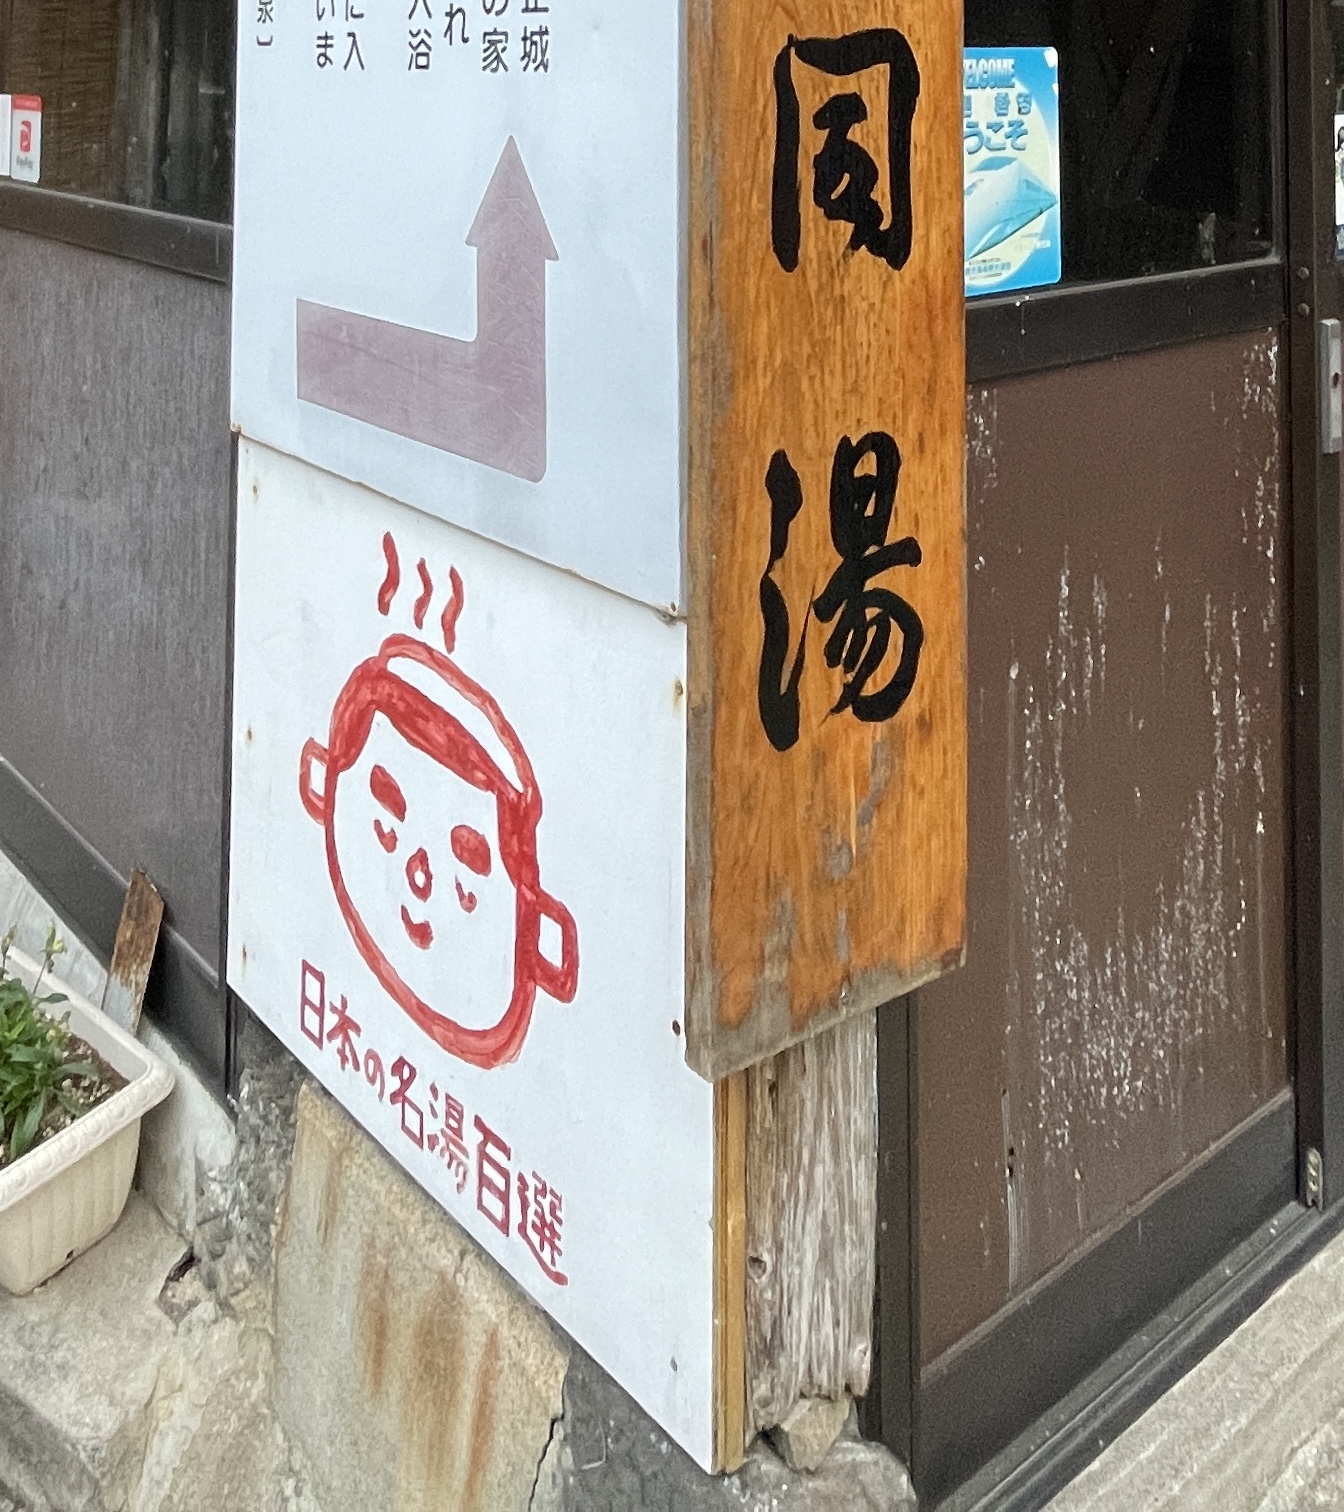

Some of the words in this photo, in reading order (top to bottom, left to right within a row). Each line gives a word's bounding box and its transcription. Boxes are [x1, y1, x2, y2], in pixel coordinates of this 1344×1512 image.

[299, 958, 569, 1287] 日本の名湯百選
